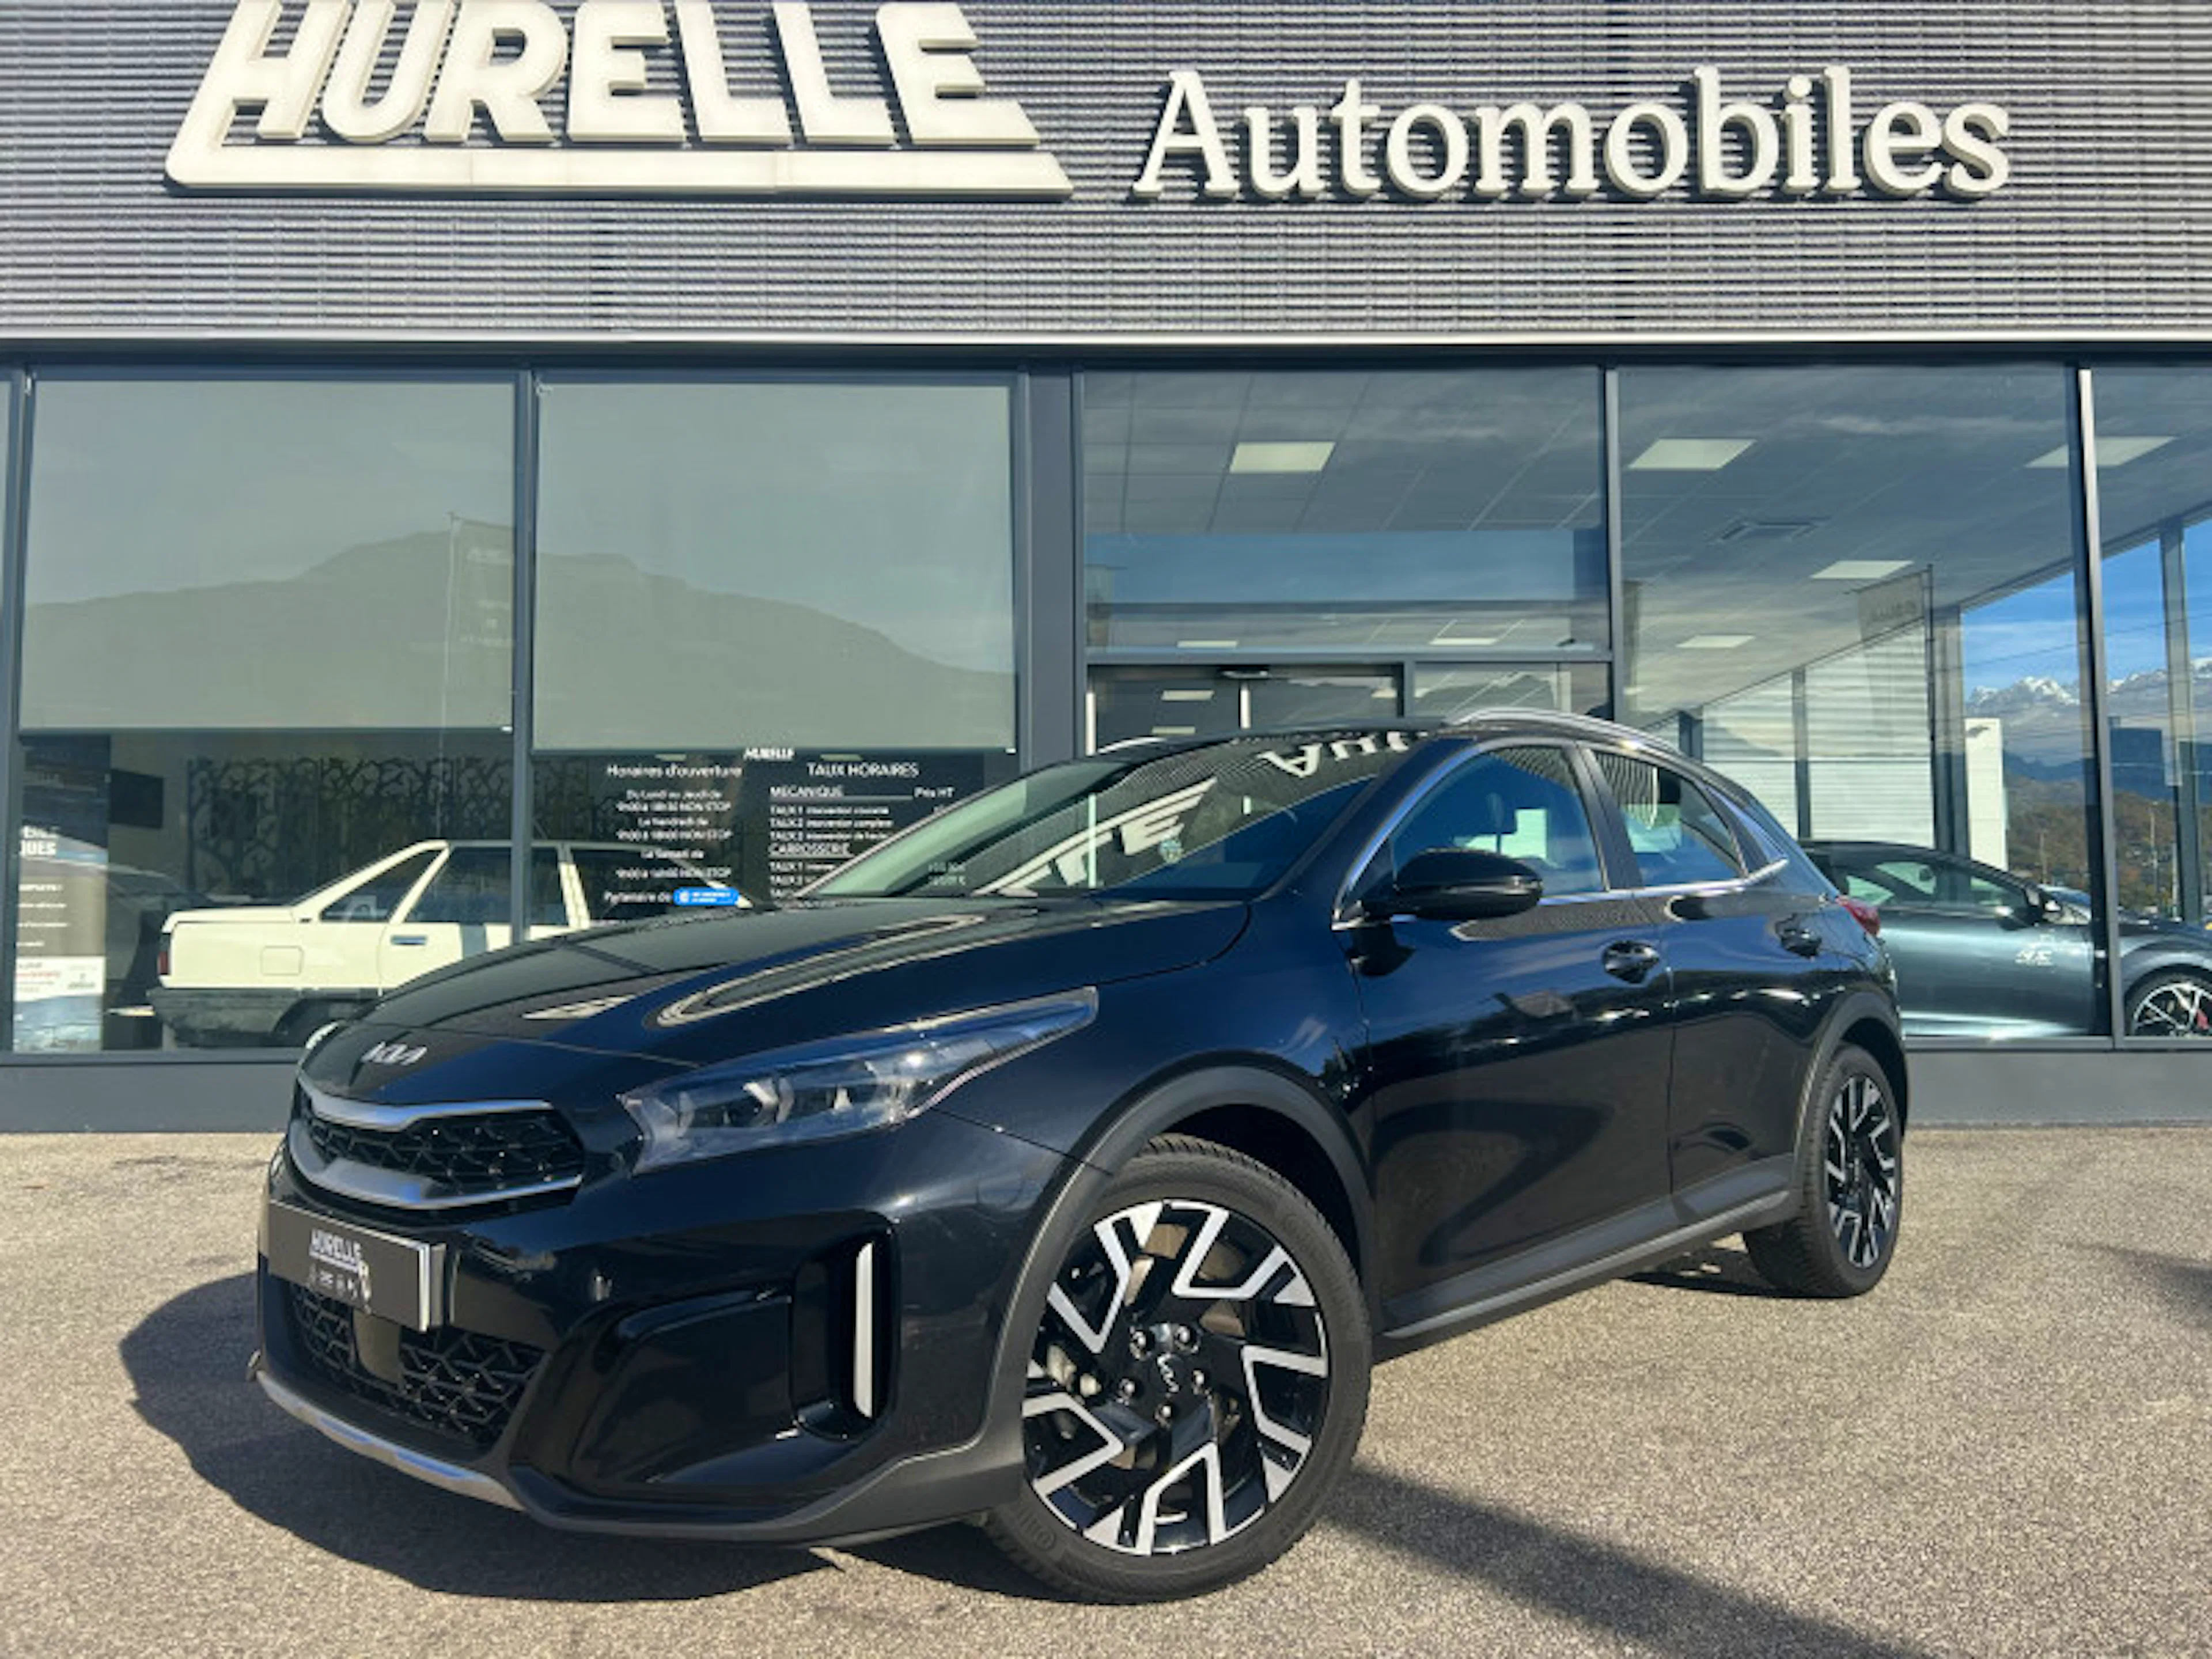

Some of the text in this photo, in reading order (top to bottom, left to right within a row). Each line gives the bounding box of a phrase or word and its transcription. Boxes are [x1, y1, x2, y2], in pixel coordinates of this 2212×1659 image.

[165, 0, 2010, 199] HURELLE Automobiles
[607, 765, 663, 778] Horaires
[808, 763, 920, 777] TAUX HORAIRES
